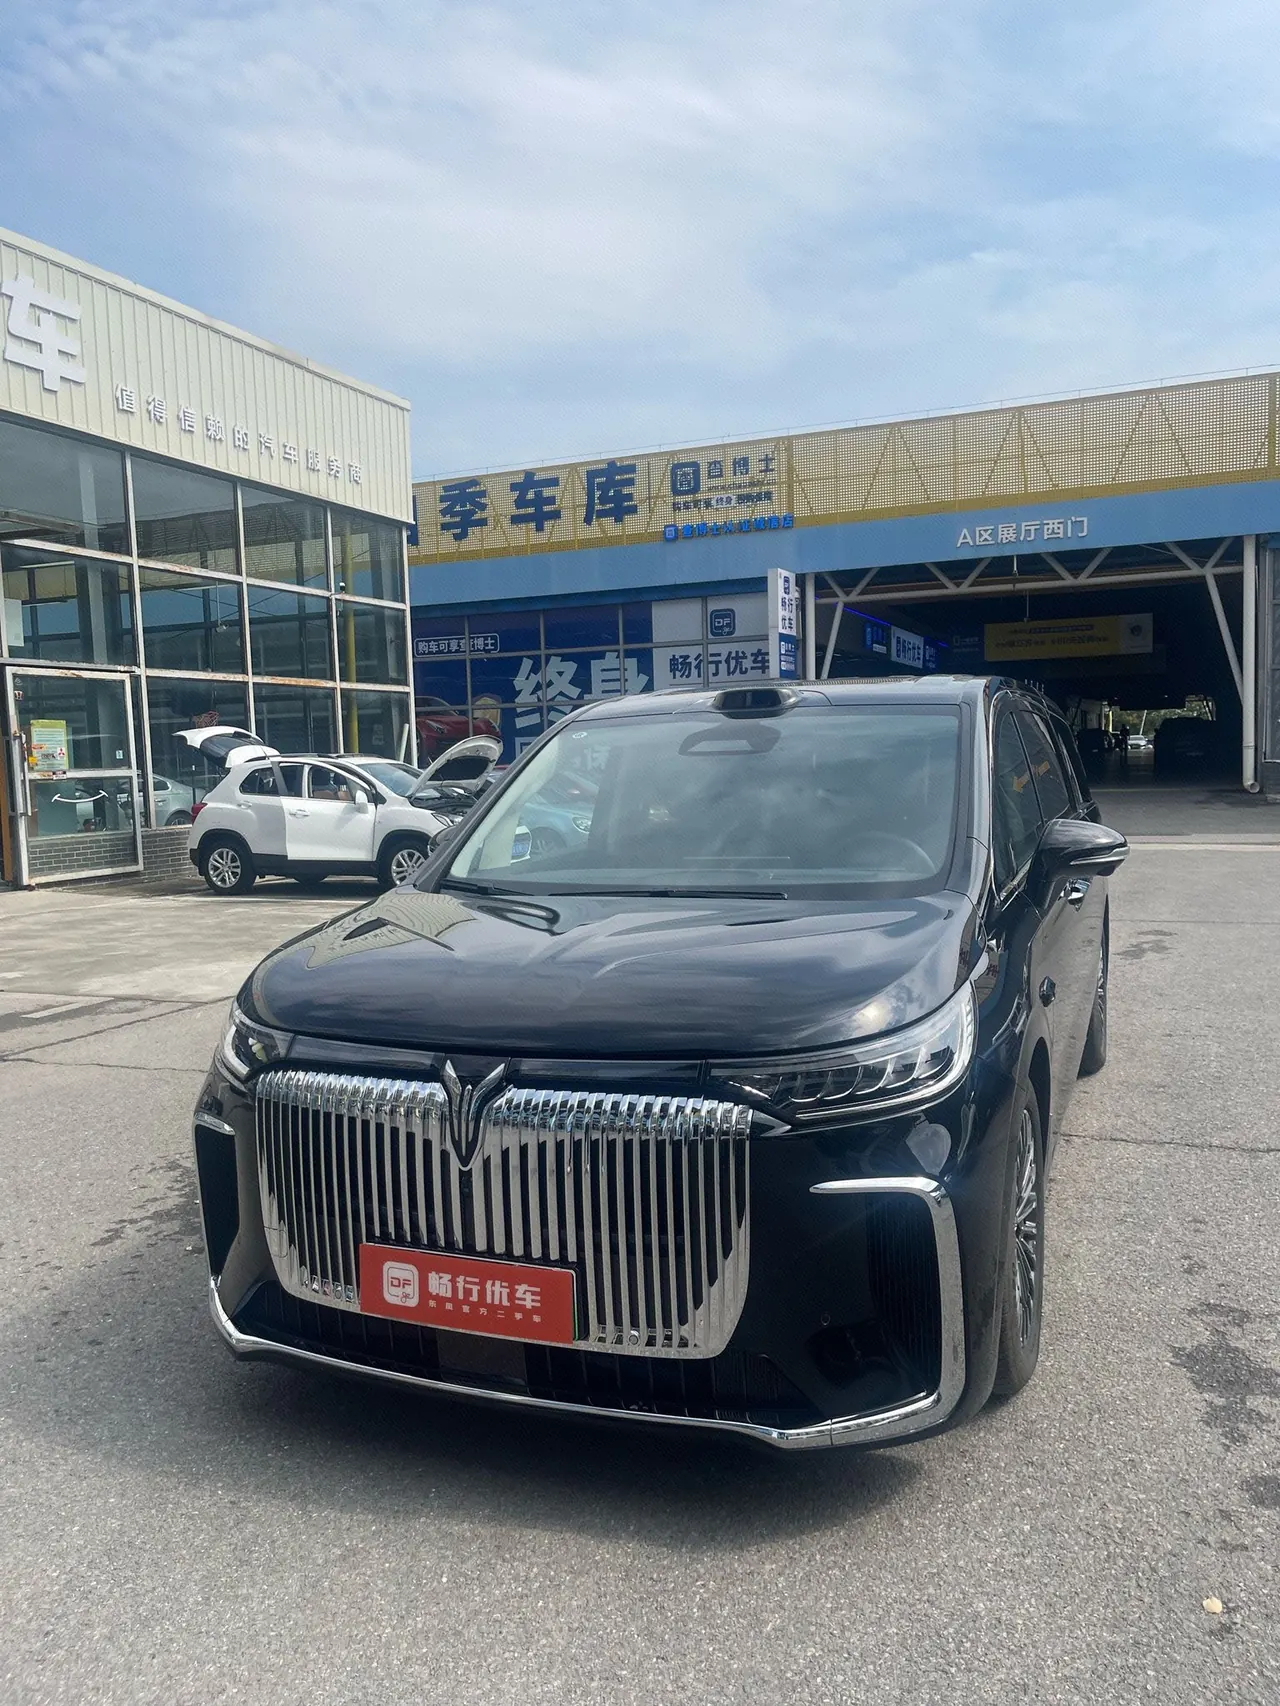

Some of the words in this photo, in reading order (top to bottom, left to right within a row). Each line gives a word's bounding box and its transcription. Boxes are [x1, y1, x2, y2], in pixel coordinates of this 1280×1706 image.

[1, 275, 86, 392] 车
[115, 383, 362, 484] 值得信赖的汽车服务商
[407, 460, 637, 545] 季车库
[957, 516, 1088, 549] A区展厅西门
[417, 640, 496, 654] 购车可享查博士
[669, 648, 770, 680] 畅行优车
[513, 651, 649, 730] 终身
[428, 1271, 541, 1309] 畅行优车
[428, 1299, 542, 1323] 东风官方二手车
